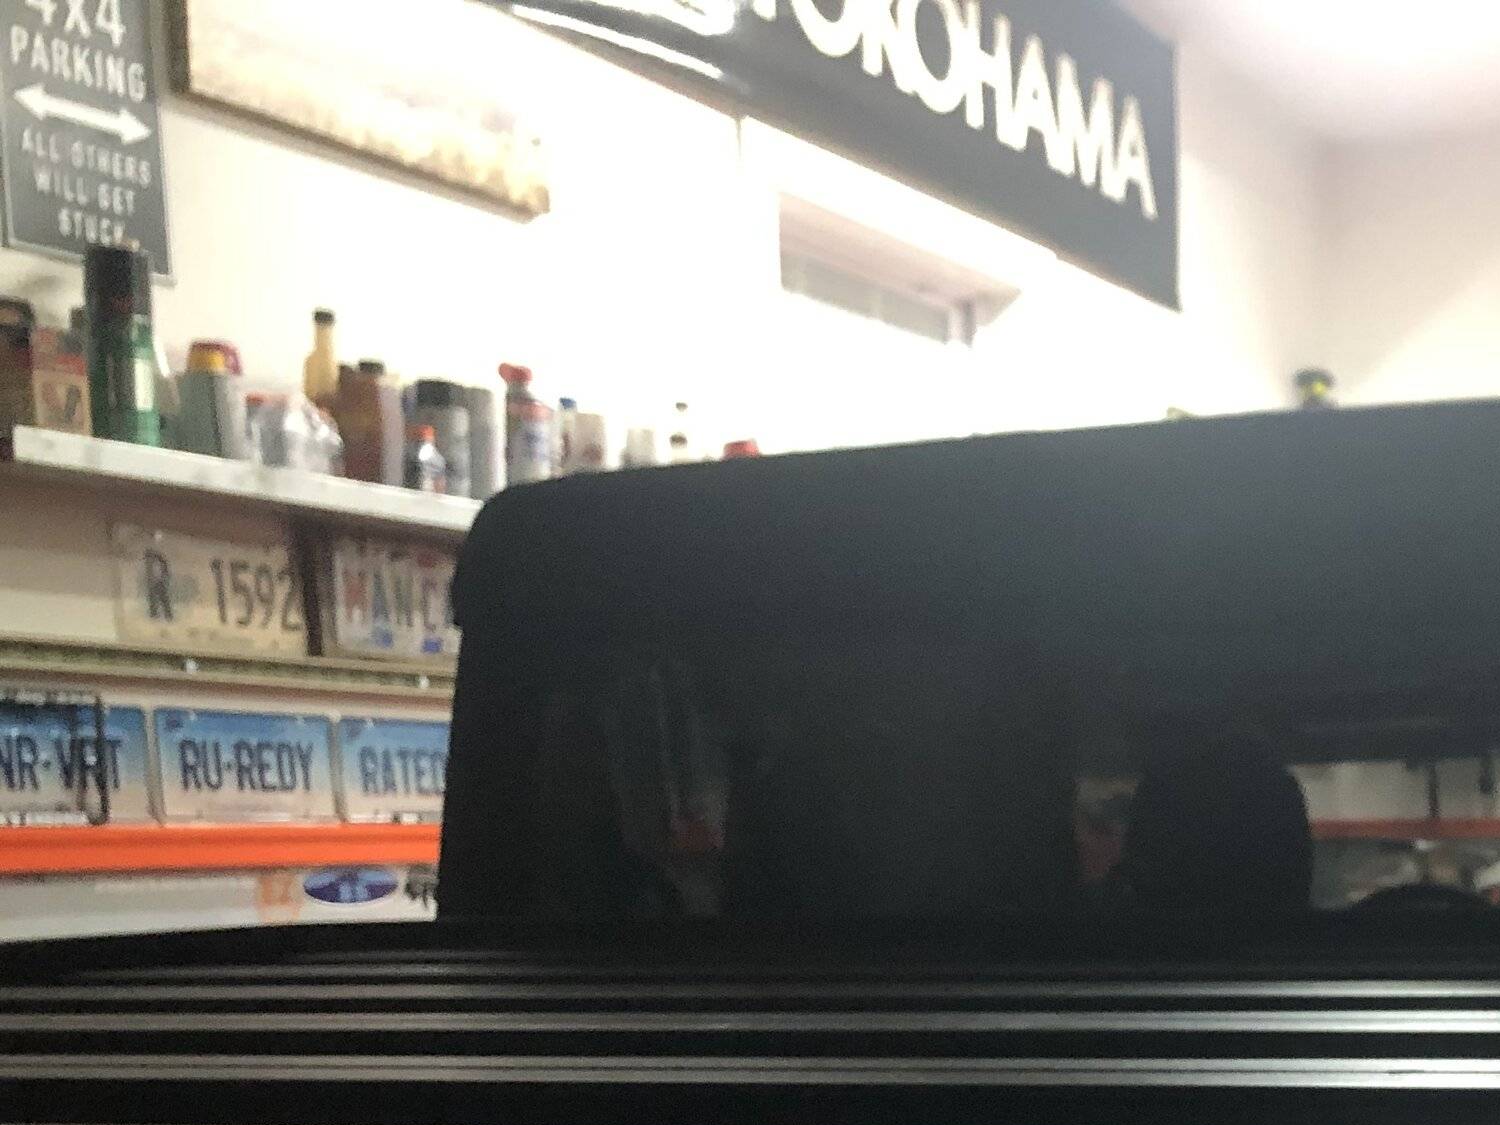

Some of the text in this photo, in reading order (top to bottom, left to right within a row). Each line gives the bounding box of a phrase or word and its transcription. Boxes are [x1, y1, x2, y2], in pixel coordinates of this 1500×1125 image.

[10, 25, 147, 102] PARKING
[752, 0, 1158, 219] KOHAMA
[21, 127, 151, 188] ALL OTHERS
[35, 165, 88, 206] WILL
